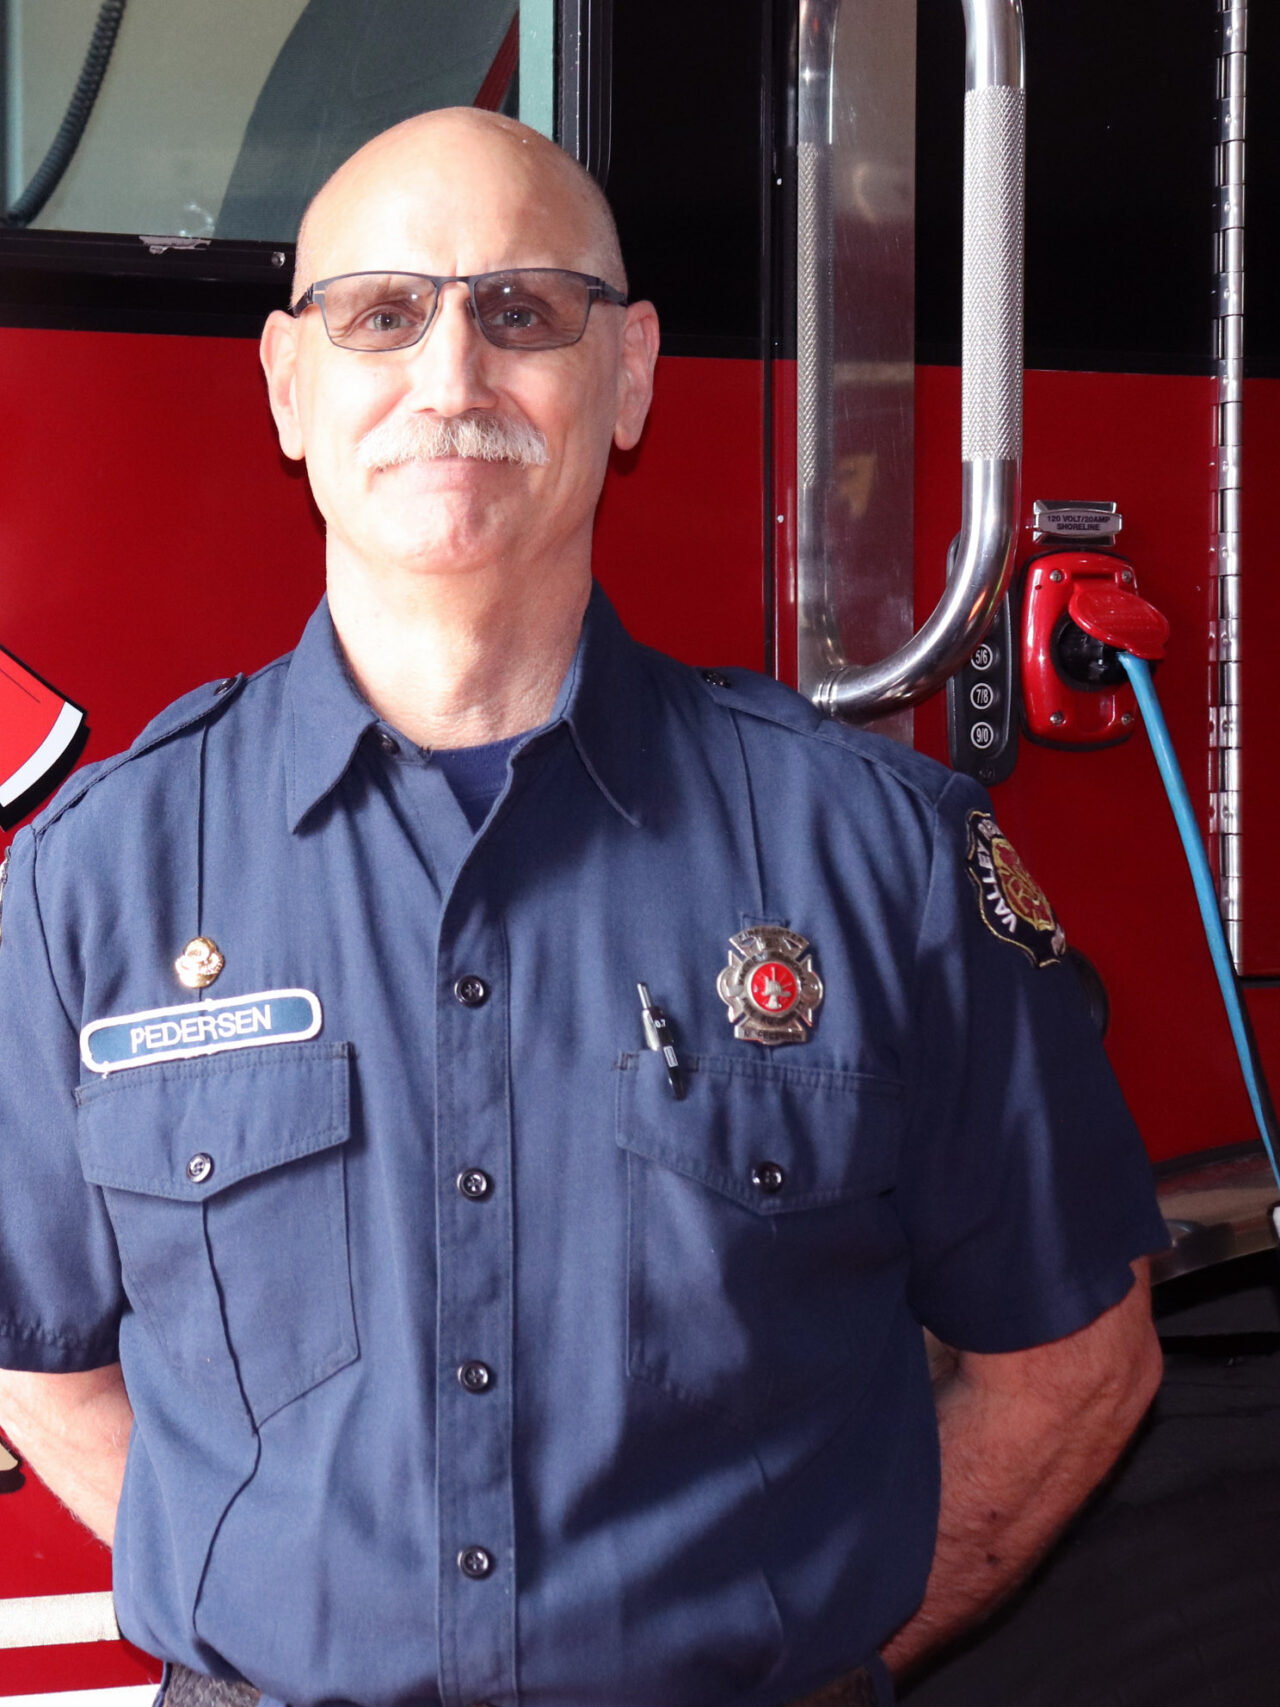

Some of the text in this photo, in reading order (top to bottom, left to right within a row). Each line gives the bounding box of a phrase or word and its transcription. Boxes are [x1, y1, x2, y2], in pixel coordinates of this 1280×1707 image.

[1047, 515, 1061, 523] 120
[1056, 523, 1101, 531] SHORELINE
[975, 649, 988, 665] 5/6
[976, 688, 989, 704] 7/8
[976, 727, 989, 743] 9/0
[130, 1004, 273, 1053] PEDERSEN
